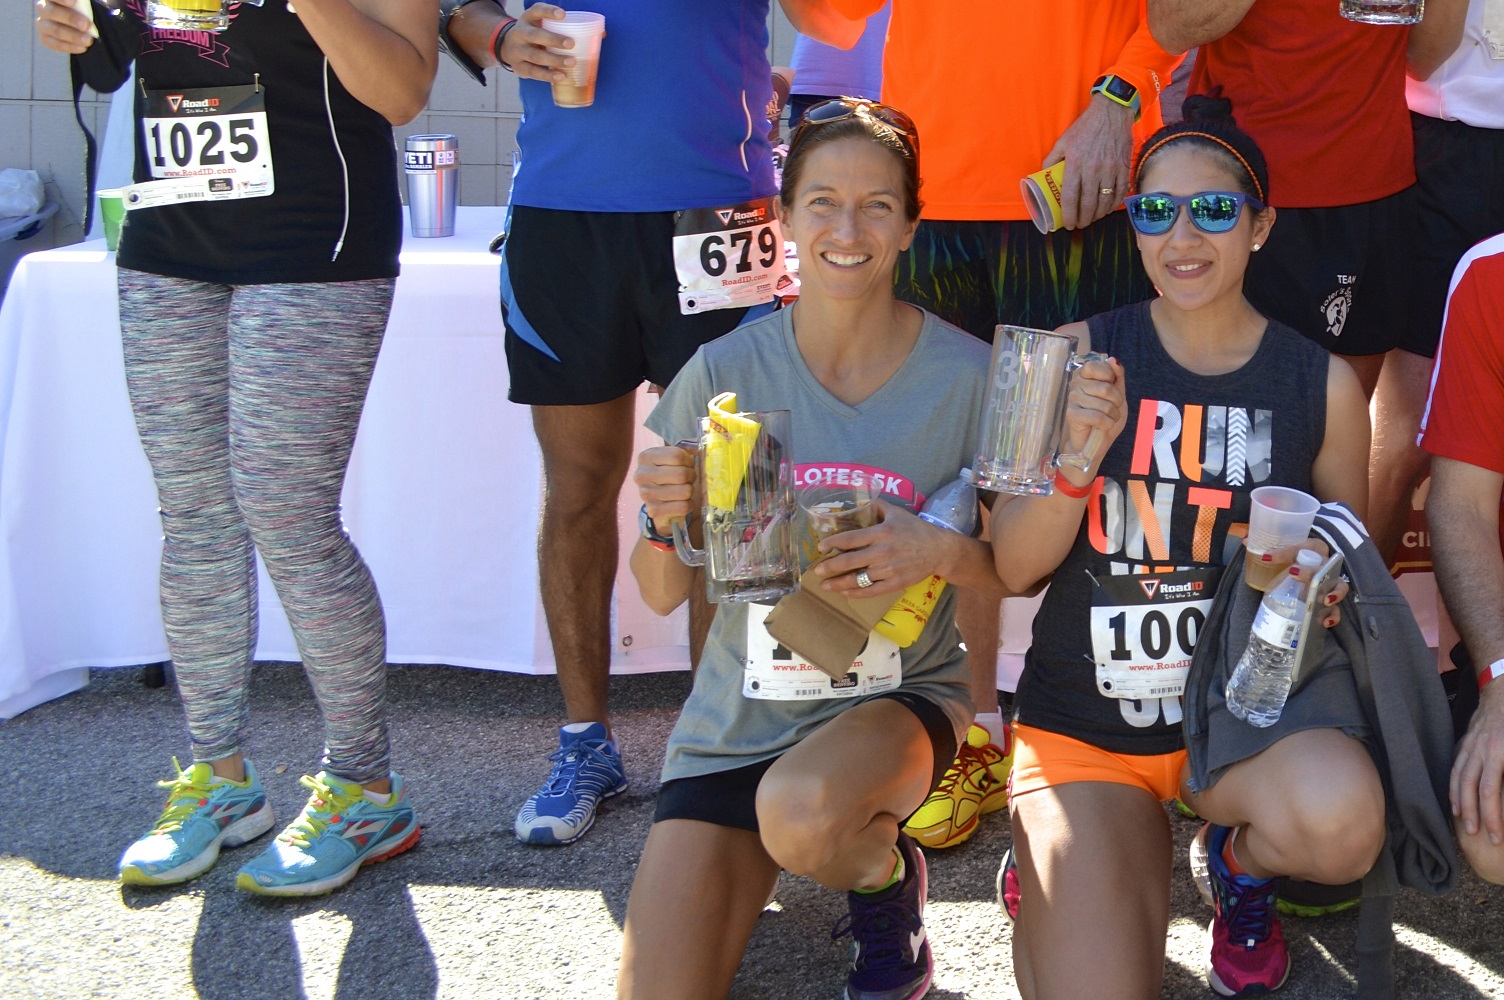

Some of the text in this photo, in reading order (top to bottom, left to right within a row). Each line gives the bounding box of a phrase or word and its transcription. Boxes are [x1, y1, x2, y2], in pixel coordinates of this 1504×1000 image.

[153, 29, 210, 47] FREEDOM
[182, 98, 220, 108] RoadID
[151, 118, 259, 168] 1025
[164, 167, 237, 177] www.RoadID.com
[734, 207, 767, 220] RoadID
[700, 227, 777, 277] 679
[722, 274, 768, 286] RoadID.com
[994, 351, 1019, 390] 3
[1130, 399, 1272, 486] RUN
[875, 473, 903, 495] 5K
[1087, 475, 1175, 560] ON
[1159, 581, 1204, 593] RoadID
